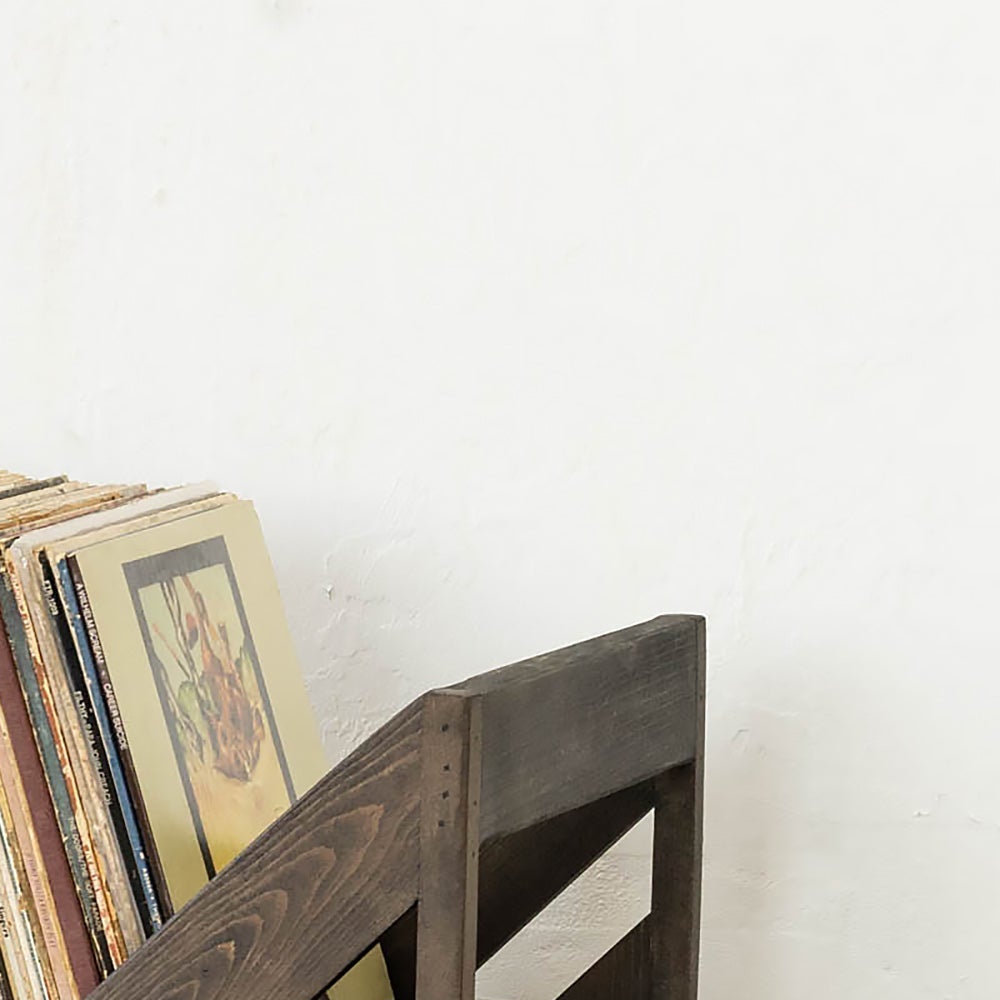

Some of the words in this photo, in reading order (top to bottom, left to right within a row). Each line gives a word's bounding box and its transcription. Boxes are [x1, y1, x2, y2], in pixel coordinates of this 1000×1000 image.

[76, 583, 84, 591] A
[77, 591, 92, 628] WILHELM
[88, 628, 104, 665] SCREAM
[102, 683, 117, 717] CAREER
[112, 718, 128, 751] SUICIDE
[90, 749, 102, 770] JOHN
[97, 771, 112, 806] CREACH
